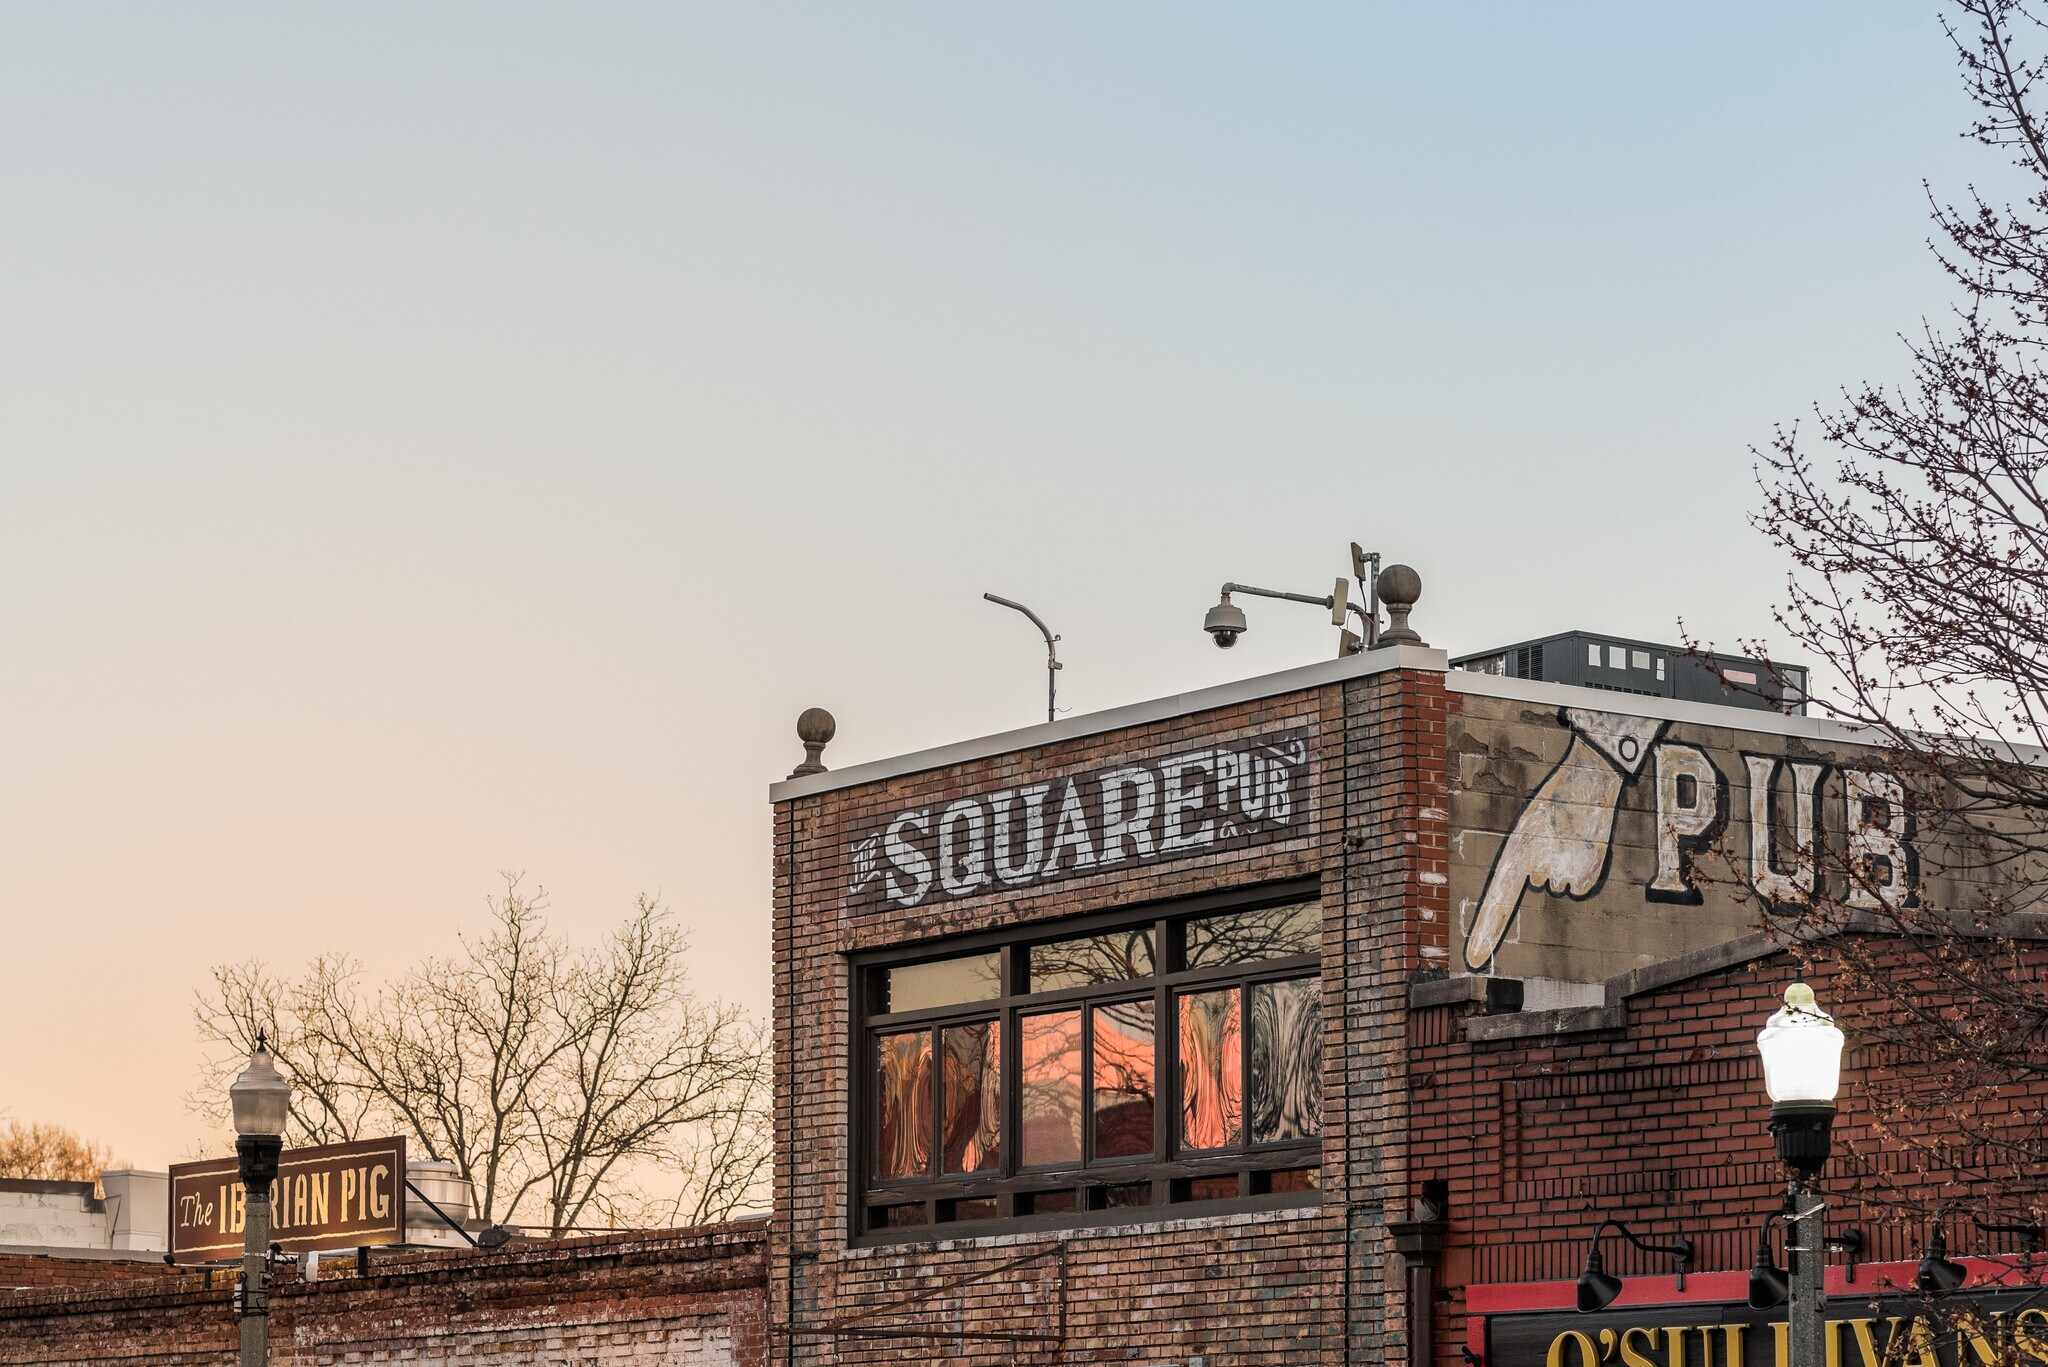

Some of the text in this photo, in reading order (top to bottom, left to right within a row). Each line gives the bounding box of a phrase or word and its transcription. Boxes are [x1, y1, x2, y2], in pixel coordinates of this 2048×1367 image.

[850, 749, 1291, 906] THE SQUARE PUB
[1648, 743, 1914, 914] PUB
[180, 1164, 390, 1234] The IBRIAN PIG
